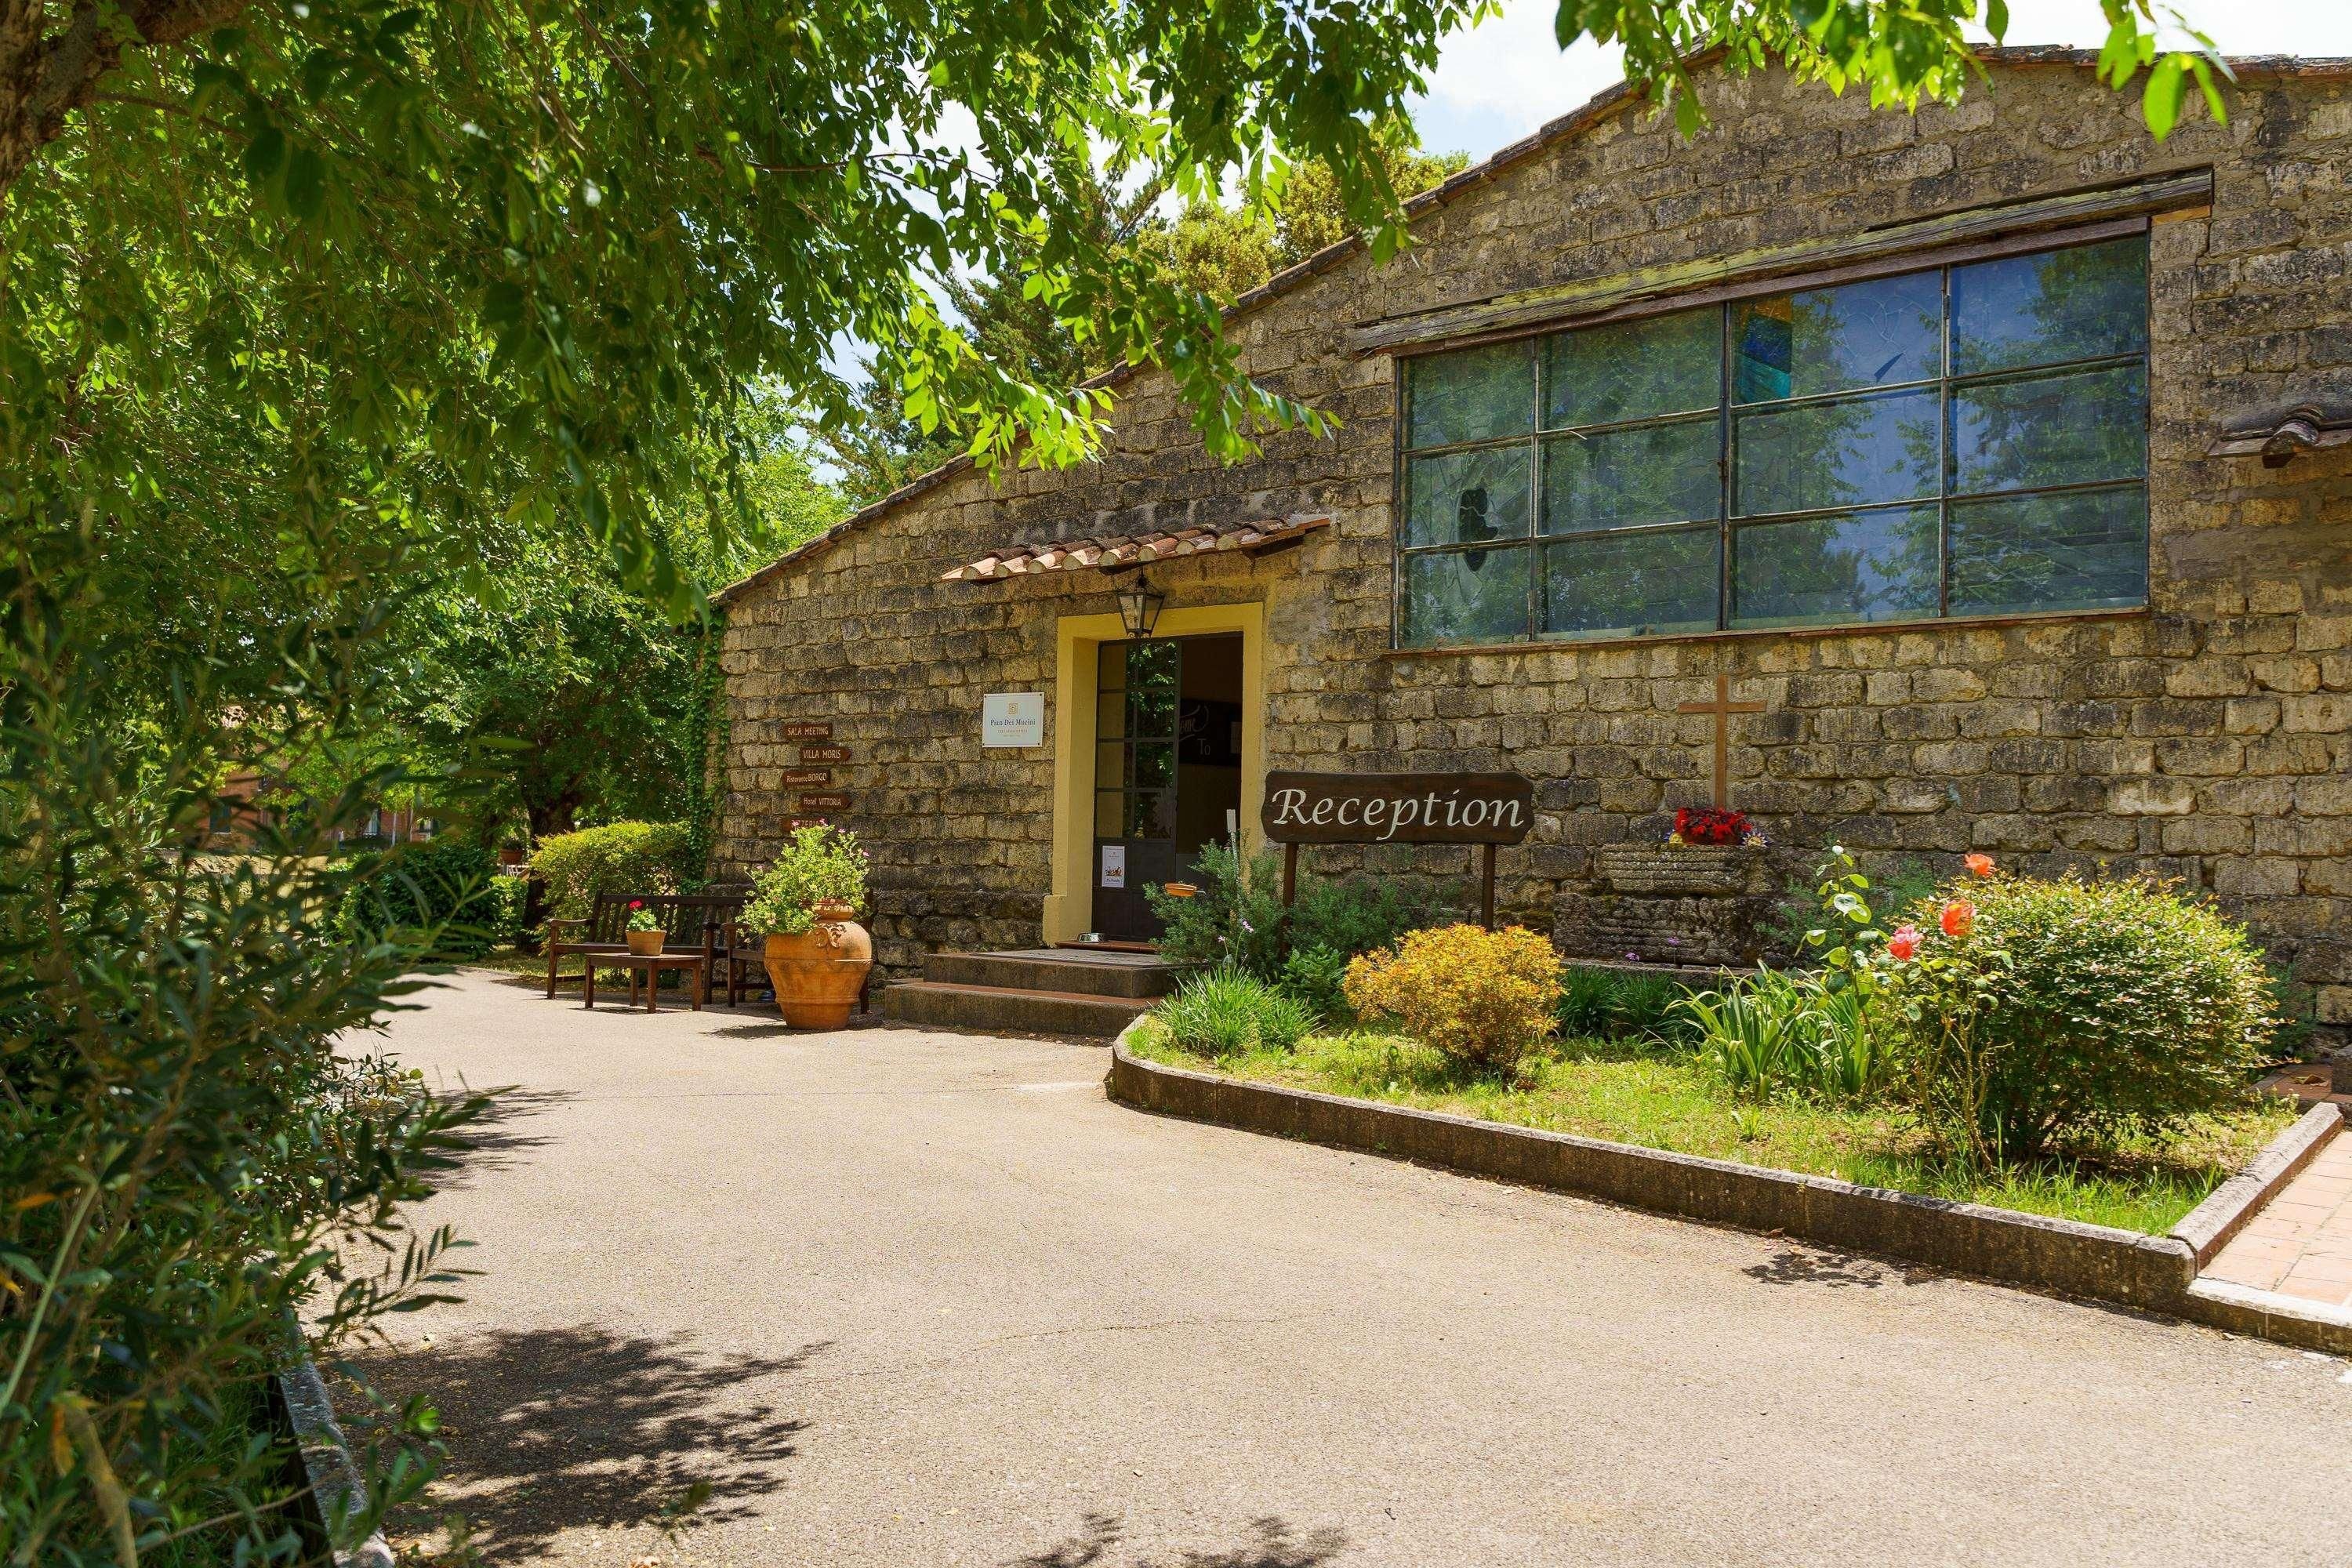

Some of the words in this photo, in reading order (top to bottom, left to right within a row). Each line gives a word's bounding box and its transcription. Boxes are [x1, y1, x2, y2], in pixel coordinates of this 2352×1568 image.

[787, 727, 802, 735] SALA
[804, 726, 829, 735] MEETING
[1197, 738, 1210, 756] To
[803, 750, 820, 759] VILLA
[822, 750, 841, 759] MORIS
[808, 772, 827, 782] BORGO
[804, 797, 817, 805] Hotel
[1271, 788, 1525, 841] Reception
[791, 819, 819, 829] ZERIA
